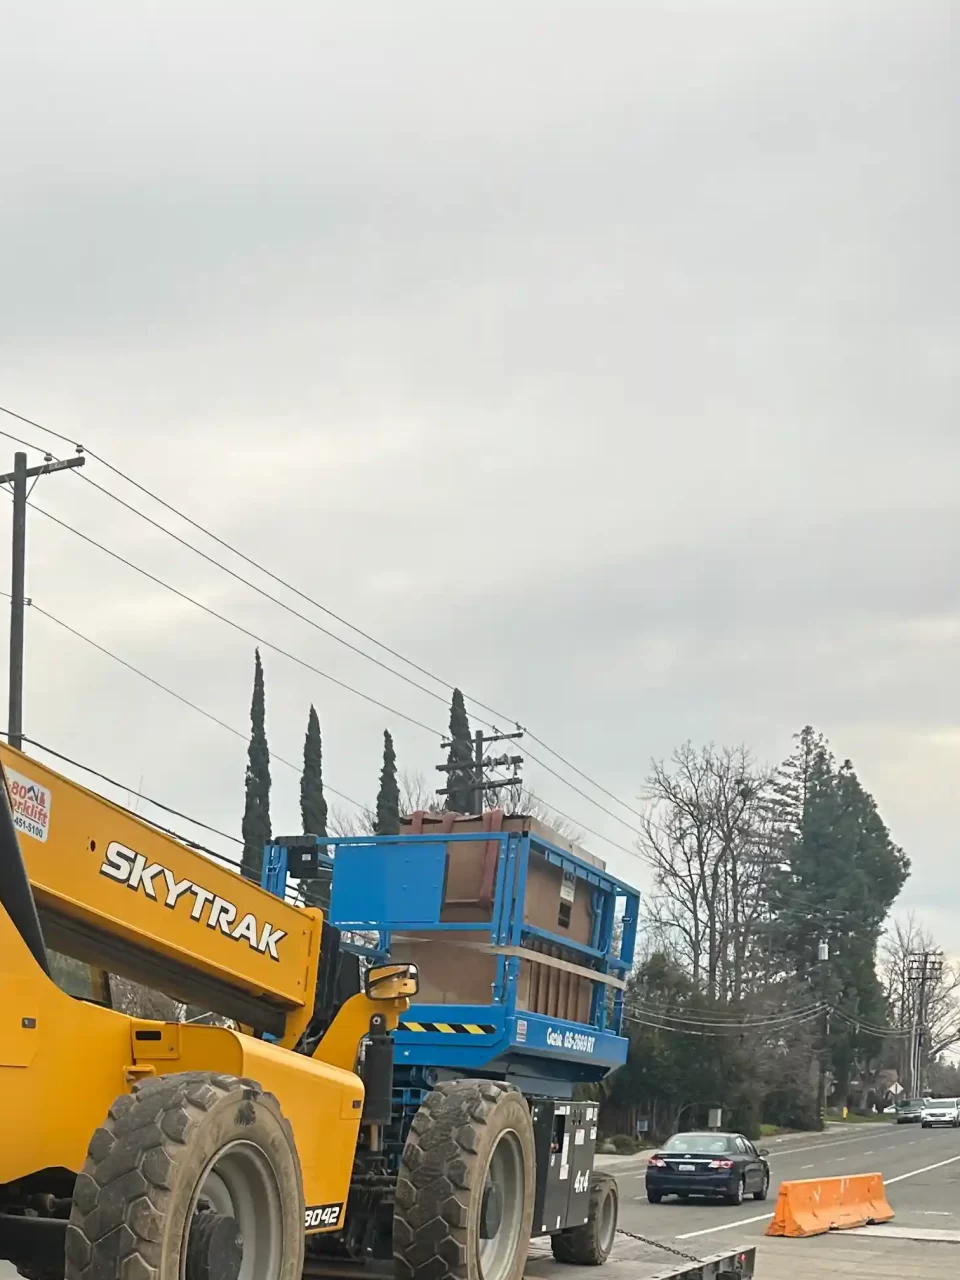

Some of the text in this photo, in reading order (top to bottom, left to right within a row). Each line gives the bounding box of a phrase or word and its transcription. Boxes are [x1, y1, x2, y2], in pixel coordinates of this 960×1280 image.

[12, 798, 49, 825] orklift
[99, 840, 288, 962] SKYTRAK
[546, 1027, 562, 1047] Genie
